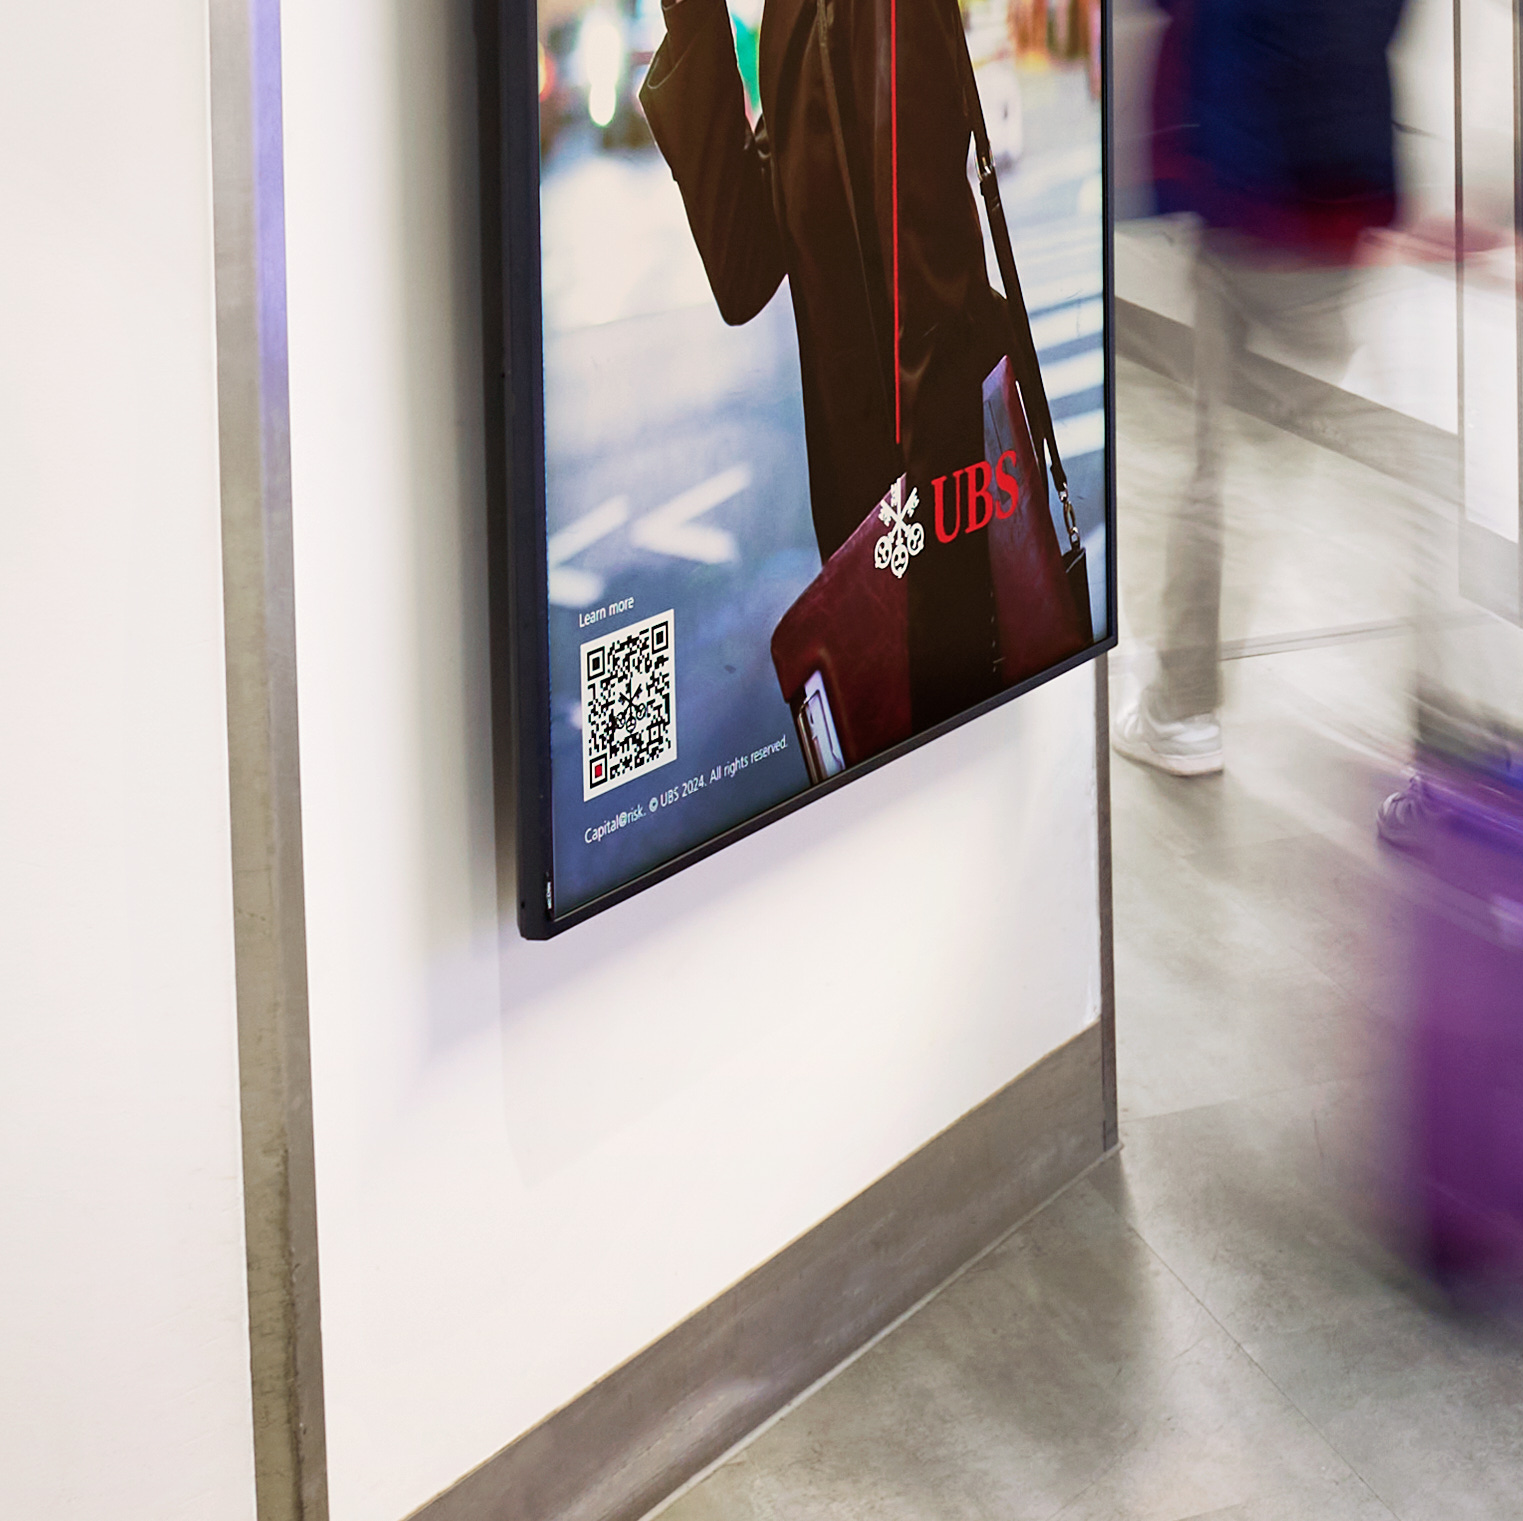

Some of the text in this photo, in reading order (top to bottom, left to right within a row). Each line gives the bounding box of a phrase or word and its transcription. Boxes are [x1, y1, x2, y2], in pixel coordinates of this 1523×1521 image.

[931, 450, 1019, 543] UBS
[579, 597, 634, 628] Learn more
[660, 786, 679, 807] UBS
[682, 775, 707, 798] 2024.
[709, 762, 722, 784] All
[723, 751, 749, 778] rights
[750, 735, 788, 763] reserved.
